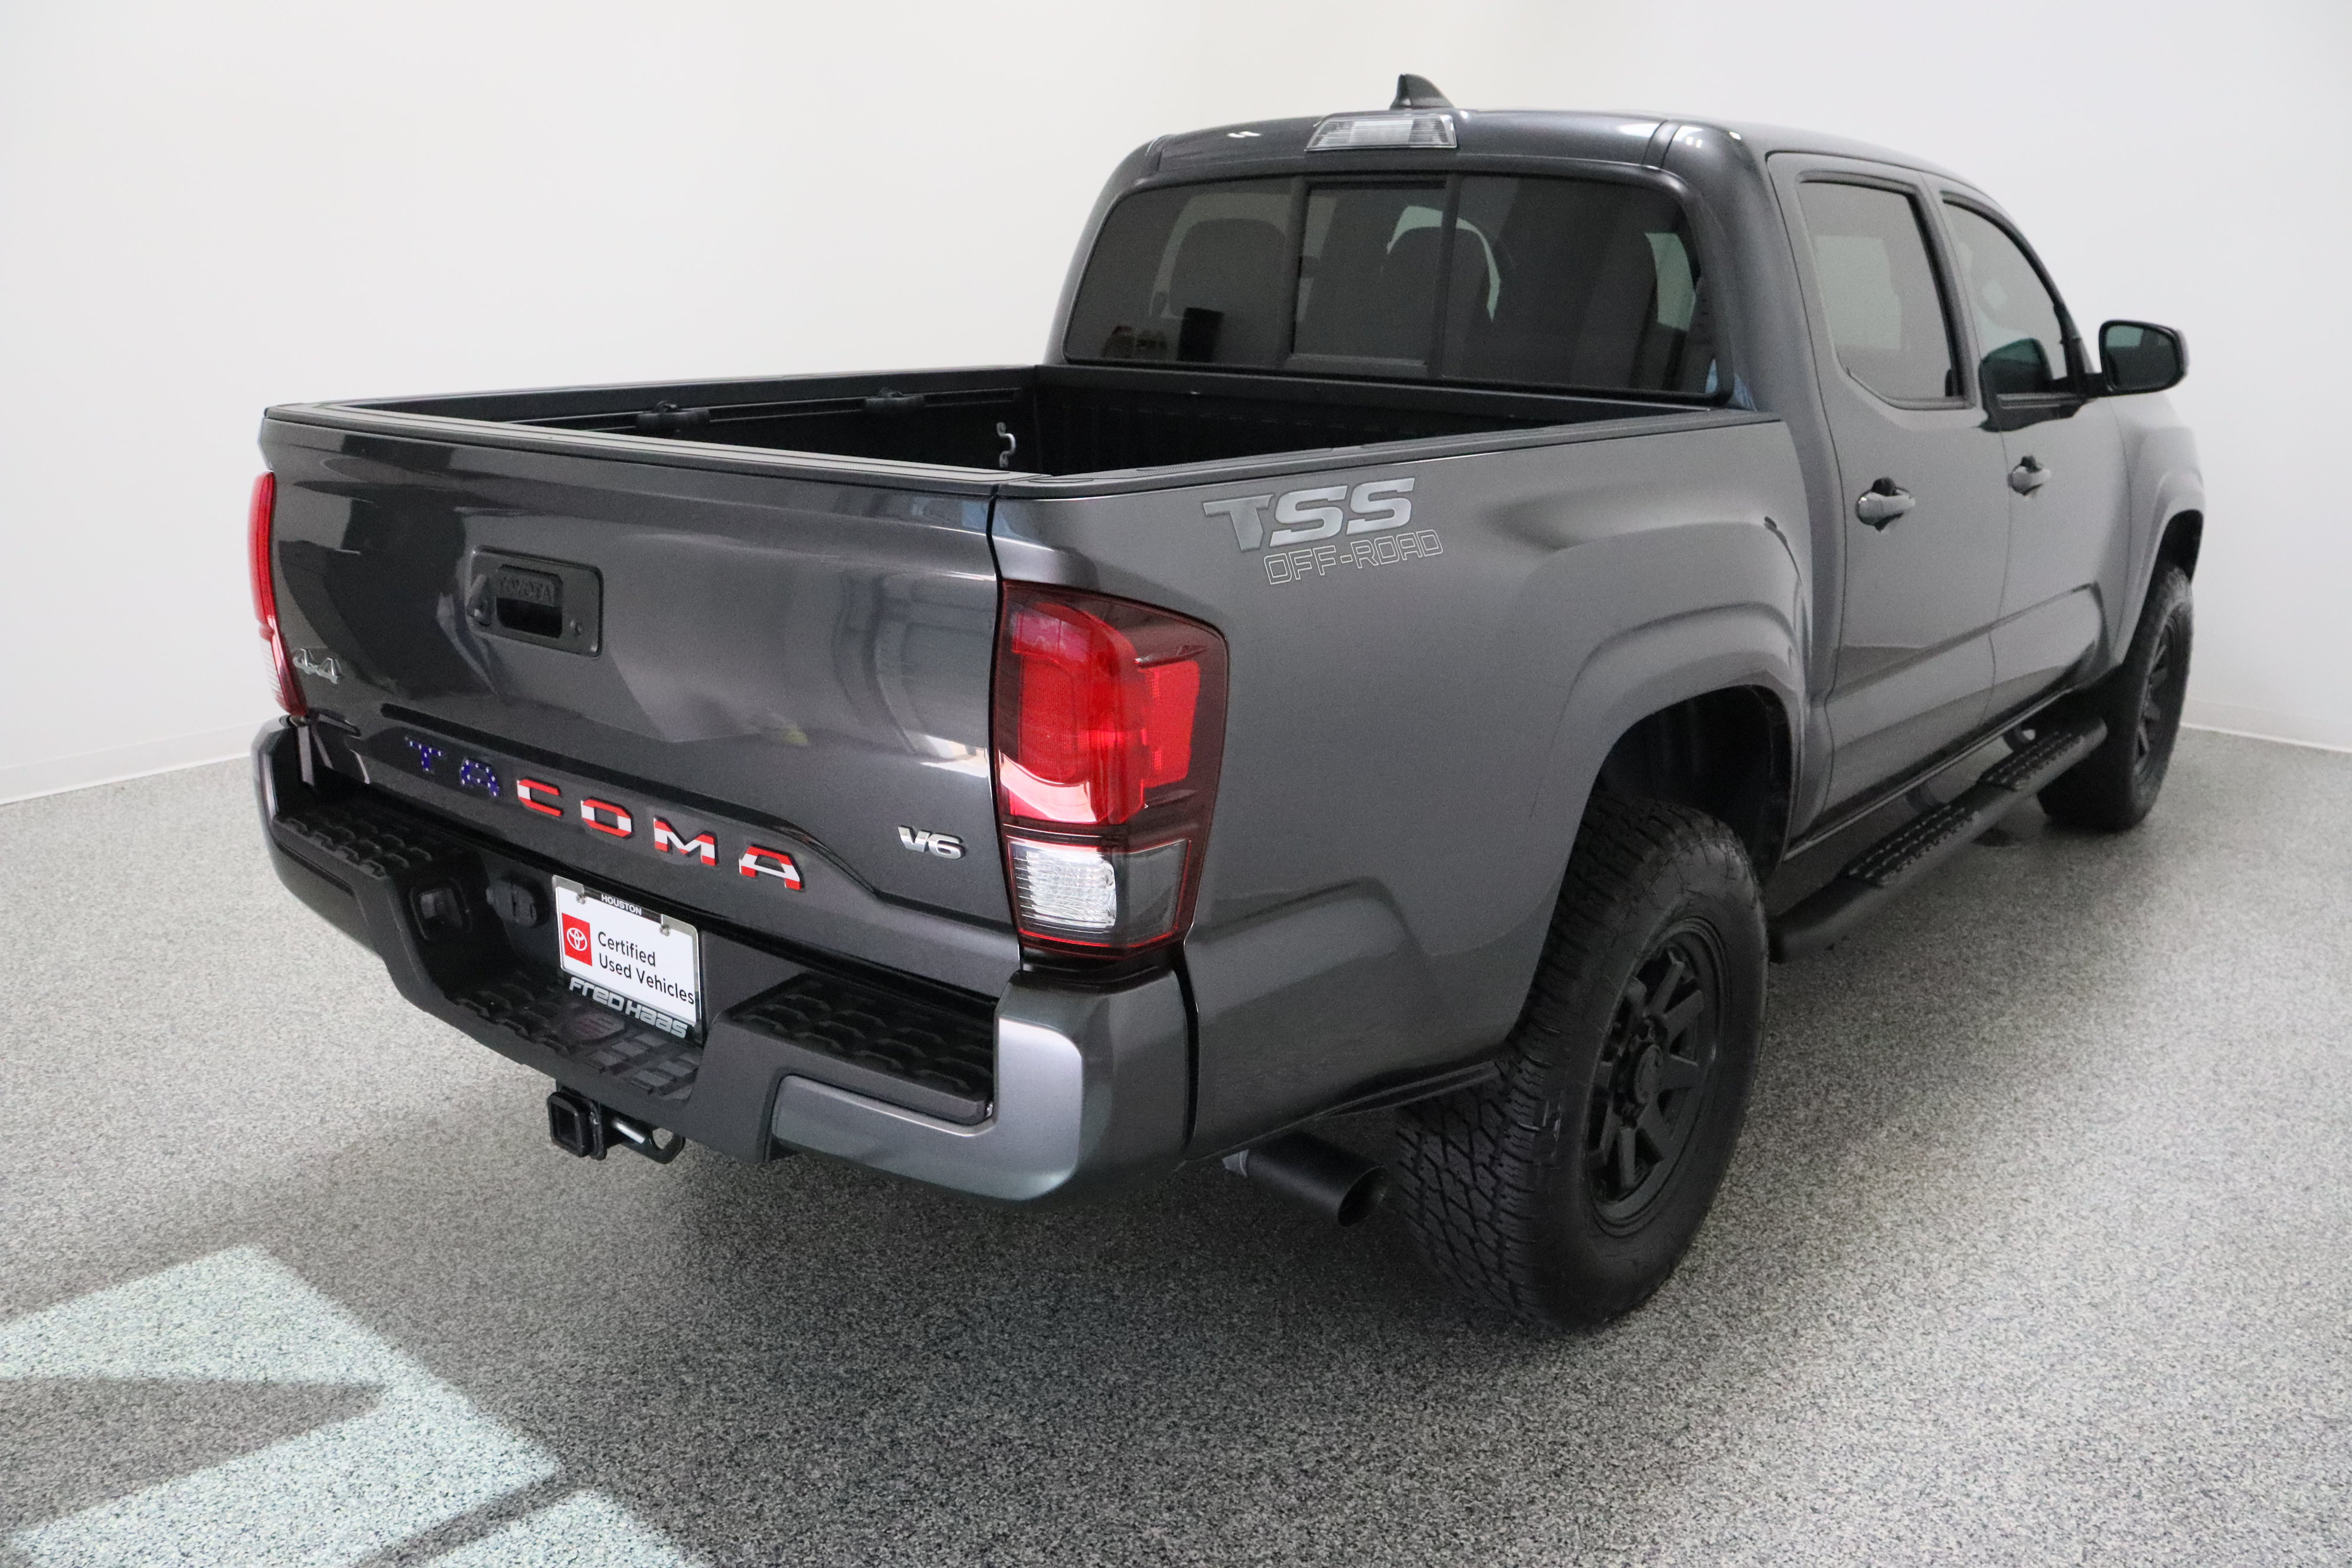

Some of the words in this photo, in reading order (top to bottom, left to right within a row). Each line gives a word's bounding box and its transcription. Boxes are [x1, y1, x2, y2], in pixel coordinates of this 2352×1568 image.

[1203, 477, 1415, 552] TSS
[1263, 529, 1443, 584] OFF-ROAD
[405, 736, 805, 890] TACOMA
[897, 826, 962, 860] V6
[601, 894, 642, 916] HOUSTON
[598, 931, 656, 967] Certified
[599, 953, 632, 979] Used
[635, 968, 694, 1005] Vehicles
